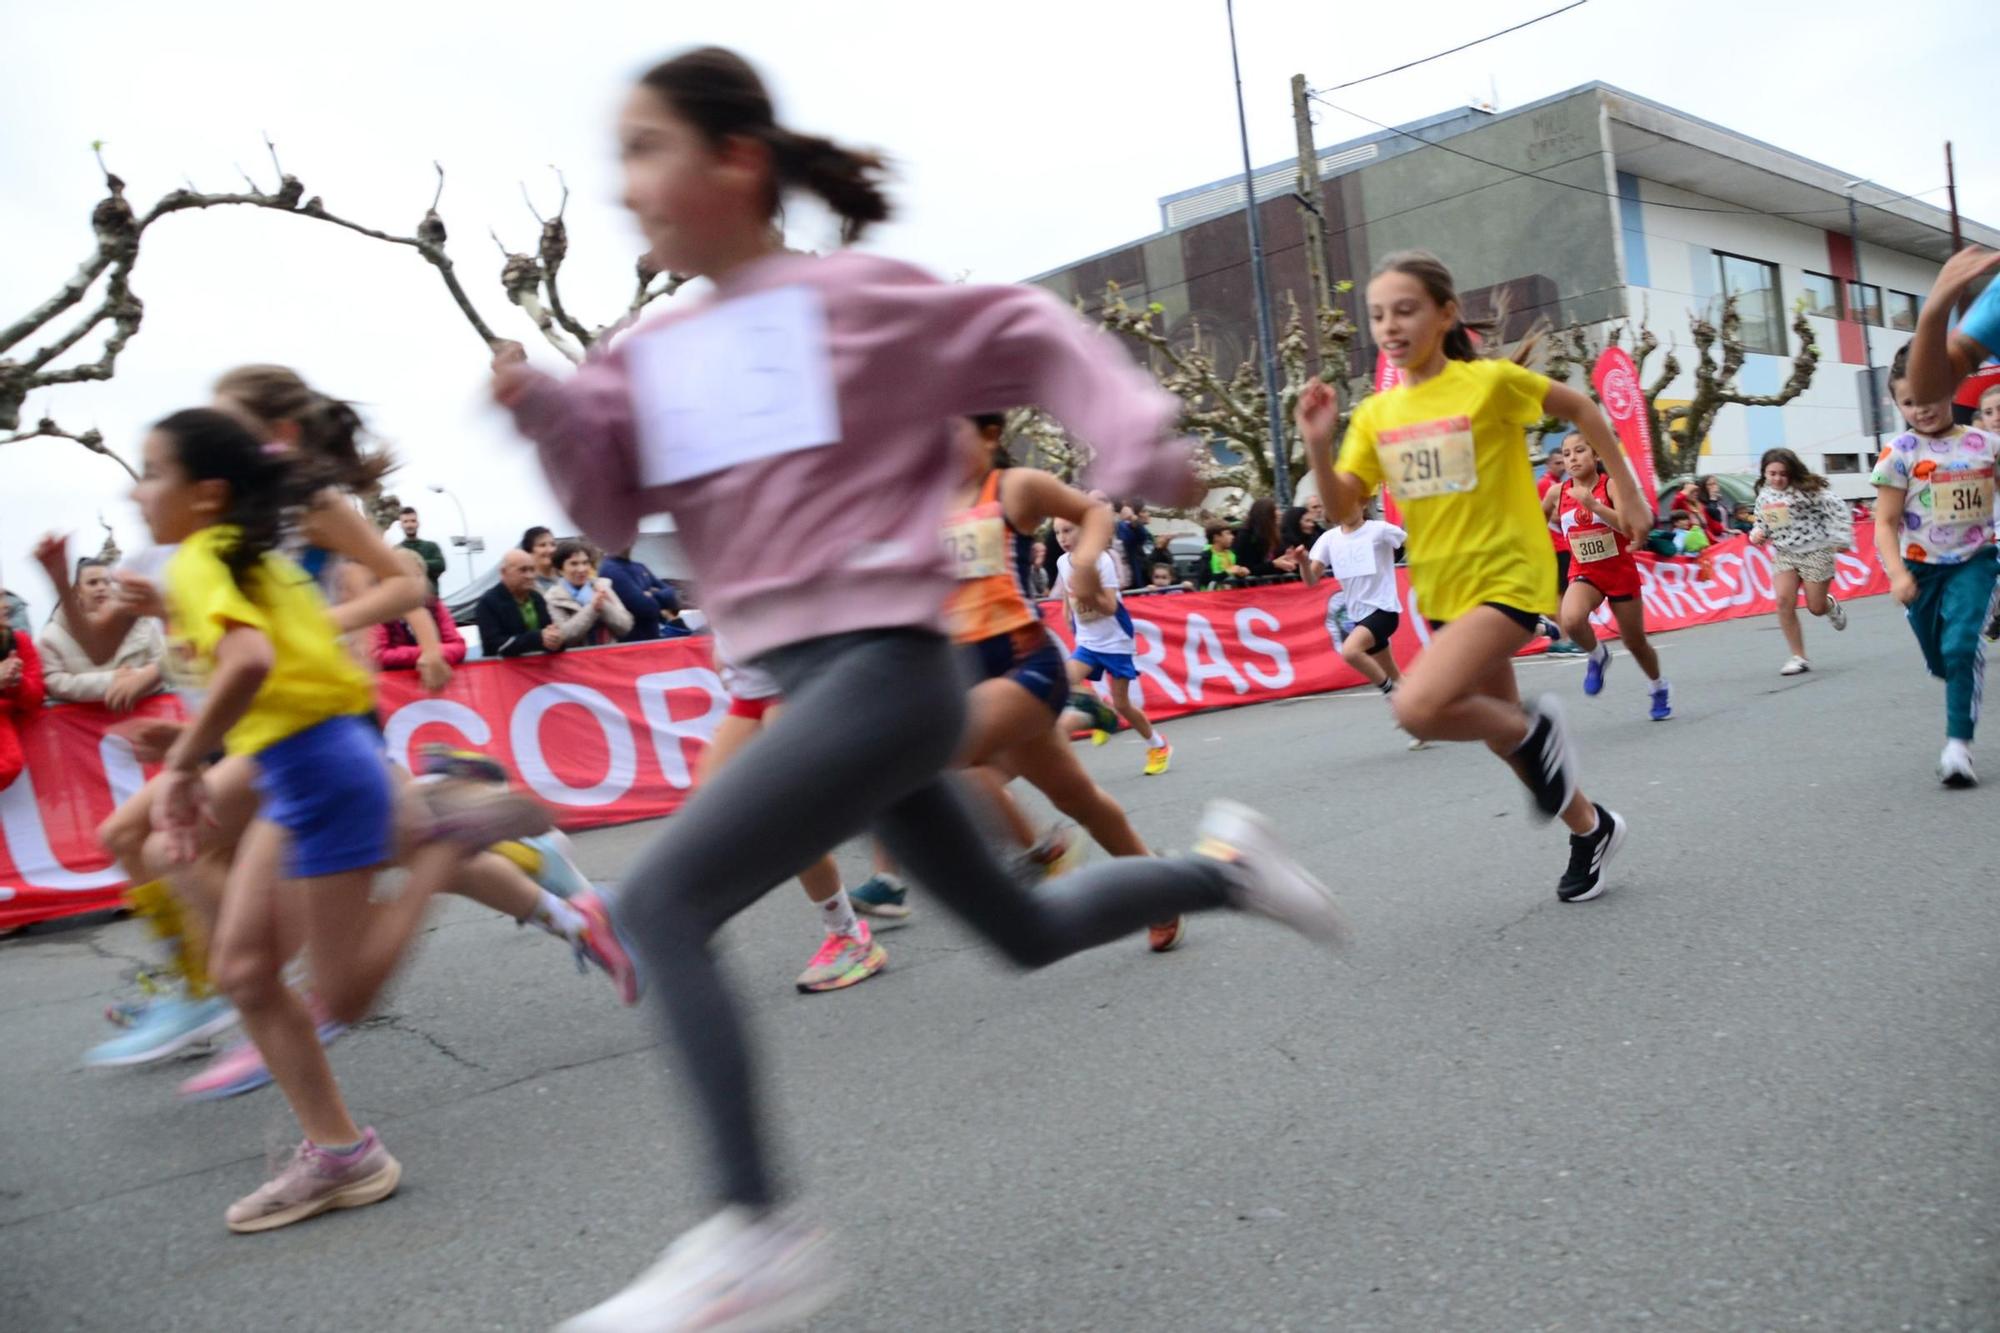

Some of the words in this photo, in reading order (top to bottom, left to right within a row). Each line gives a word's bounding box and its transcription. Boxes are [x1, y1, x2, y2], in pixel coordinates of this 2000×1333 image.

[1401, 448, 1441, 483] 291
[1952, 487, 1983, 512] 314
[1580, 539, 1606, 557] 308
